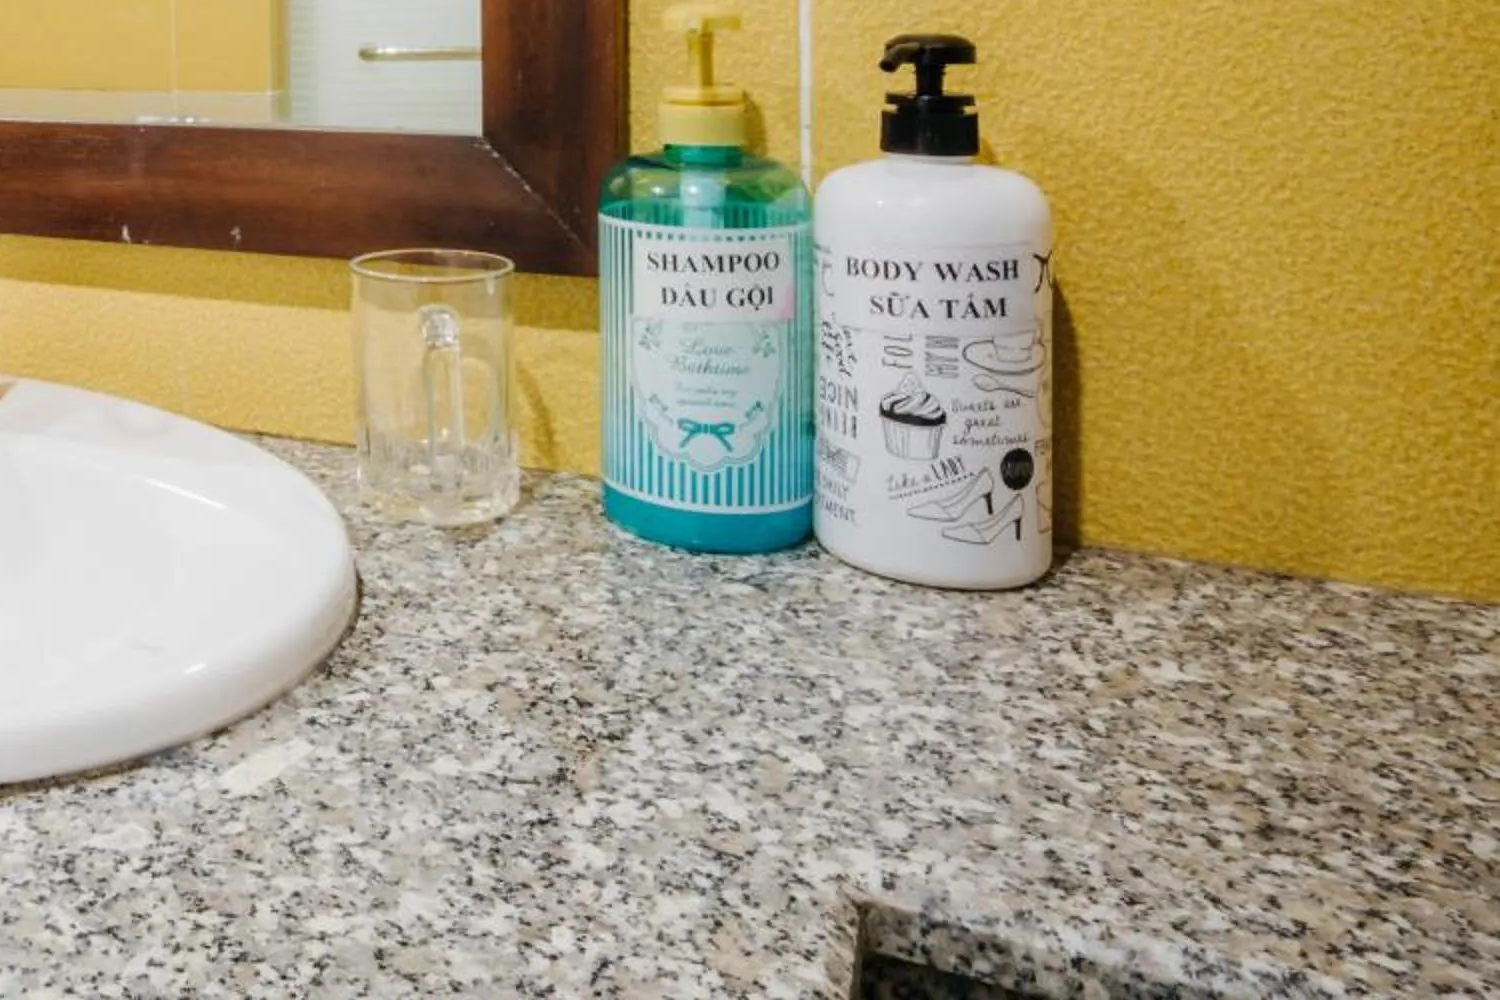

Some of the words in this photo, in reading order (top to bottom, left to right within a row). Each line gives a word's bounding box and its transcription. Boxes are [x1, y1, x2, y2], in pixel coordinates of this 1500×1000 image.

[646, 250, 781, 274] SHAMPOO
[846, 256, 923, 281] BODY
[934, 258, 1020, 282] WASH
